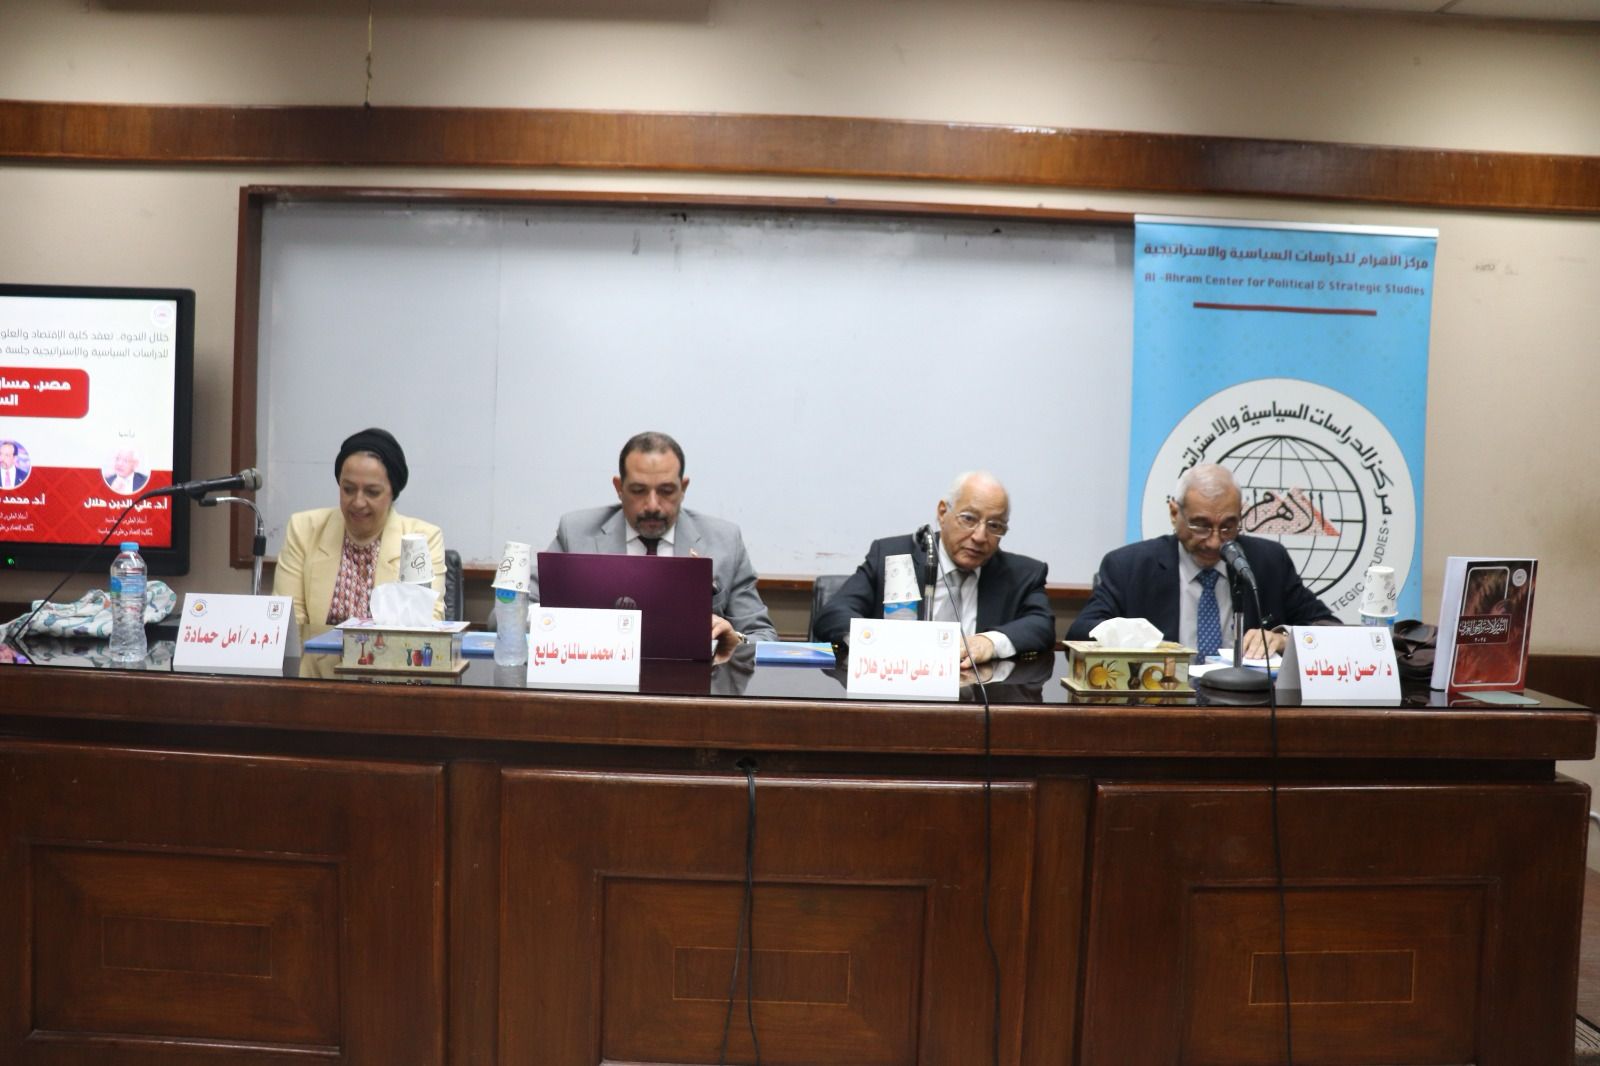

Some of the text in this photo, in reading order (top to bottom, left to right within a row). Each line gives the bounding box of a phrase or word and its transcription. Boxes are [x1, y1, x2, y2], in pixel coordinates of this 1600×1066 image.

[1144, 243, 1226, 260] والاستراتيجية
[1230, 247, 1292, 262] السياسية
[1296, 250, 1356, 265] للدراسات
[1404, 256, 1429, 270] مركز
[1205, 274, 1244, 287] Center
[1248, 276, 1265, 287] for
[1267, 278, 1315, 290] Political
[1329, 281, 1381, 295] Strategic
[1386, 283, 1425, 296] Studies
[0, 327, 29, 340] والعلو
[68, 329, 88, 341] كلية
[149, 331, 169, 344] خلال
[5, 344, 30, 356] جلسة
[91, 346, 130, 359] السياسية
[133, 347, 169, 360] للدراسات
[1242, 400, 1310, 427] السياسية
[1308, 406, 1378, 463] الدراسات
[1360, 458, 1394, 516] مركز
[2, 495, 31, 505] محمد
[83, 497, 107, 509] هلال
[108, 498, 133, 510] الدين
[1331, 526, 1389, 611] TEGIC TUDIES
[184, 625, 219, 643] حمادة
[534, 641, 559, 667] طايع
[590, 645, 614, 661] محمد
[854, 656, 878, 679] هلال
[880, 657, 908, 681] الدين
[1354, 660, 1377, 682] حسن
